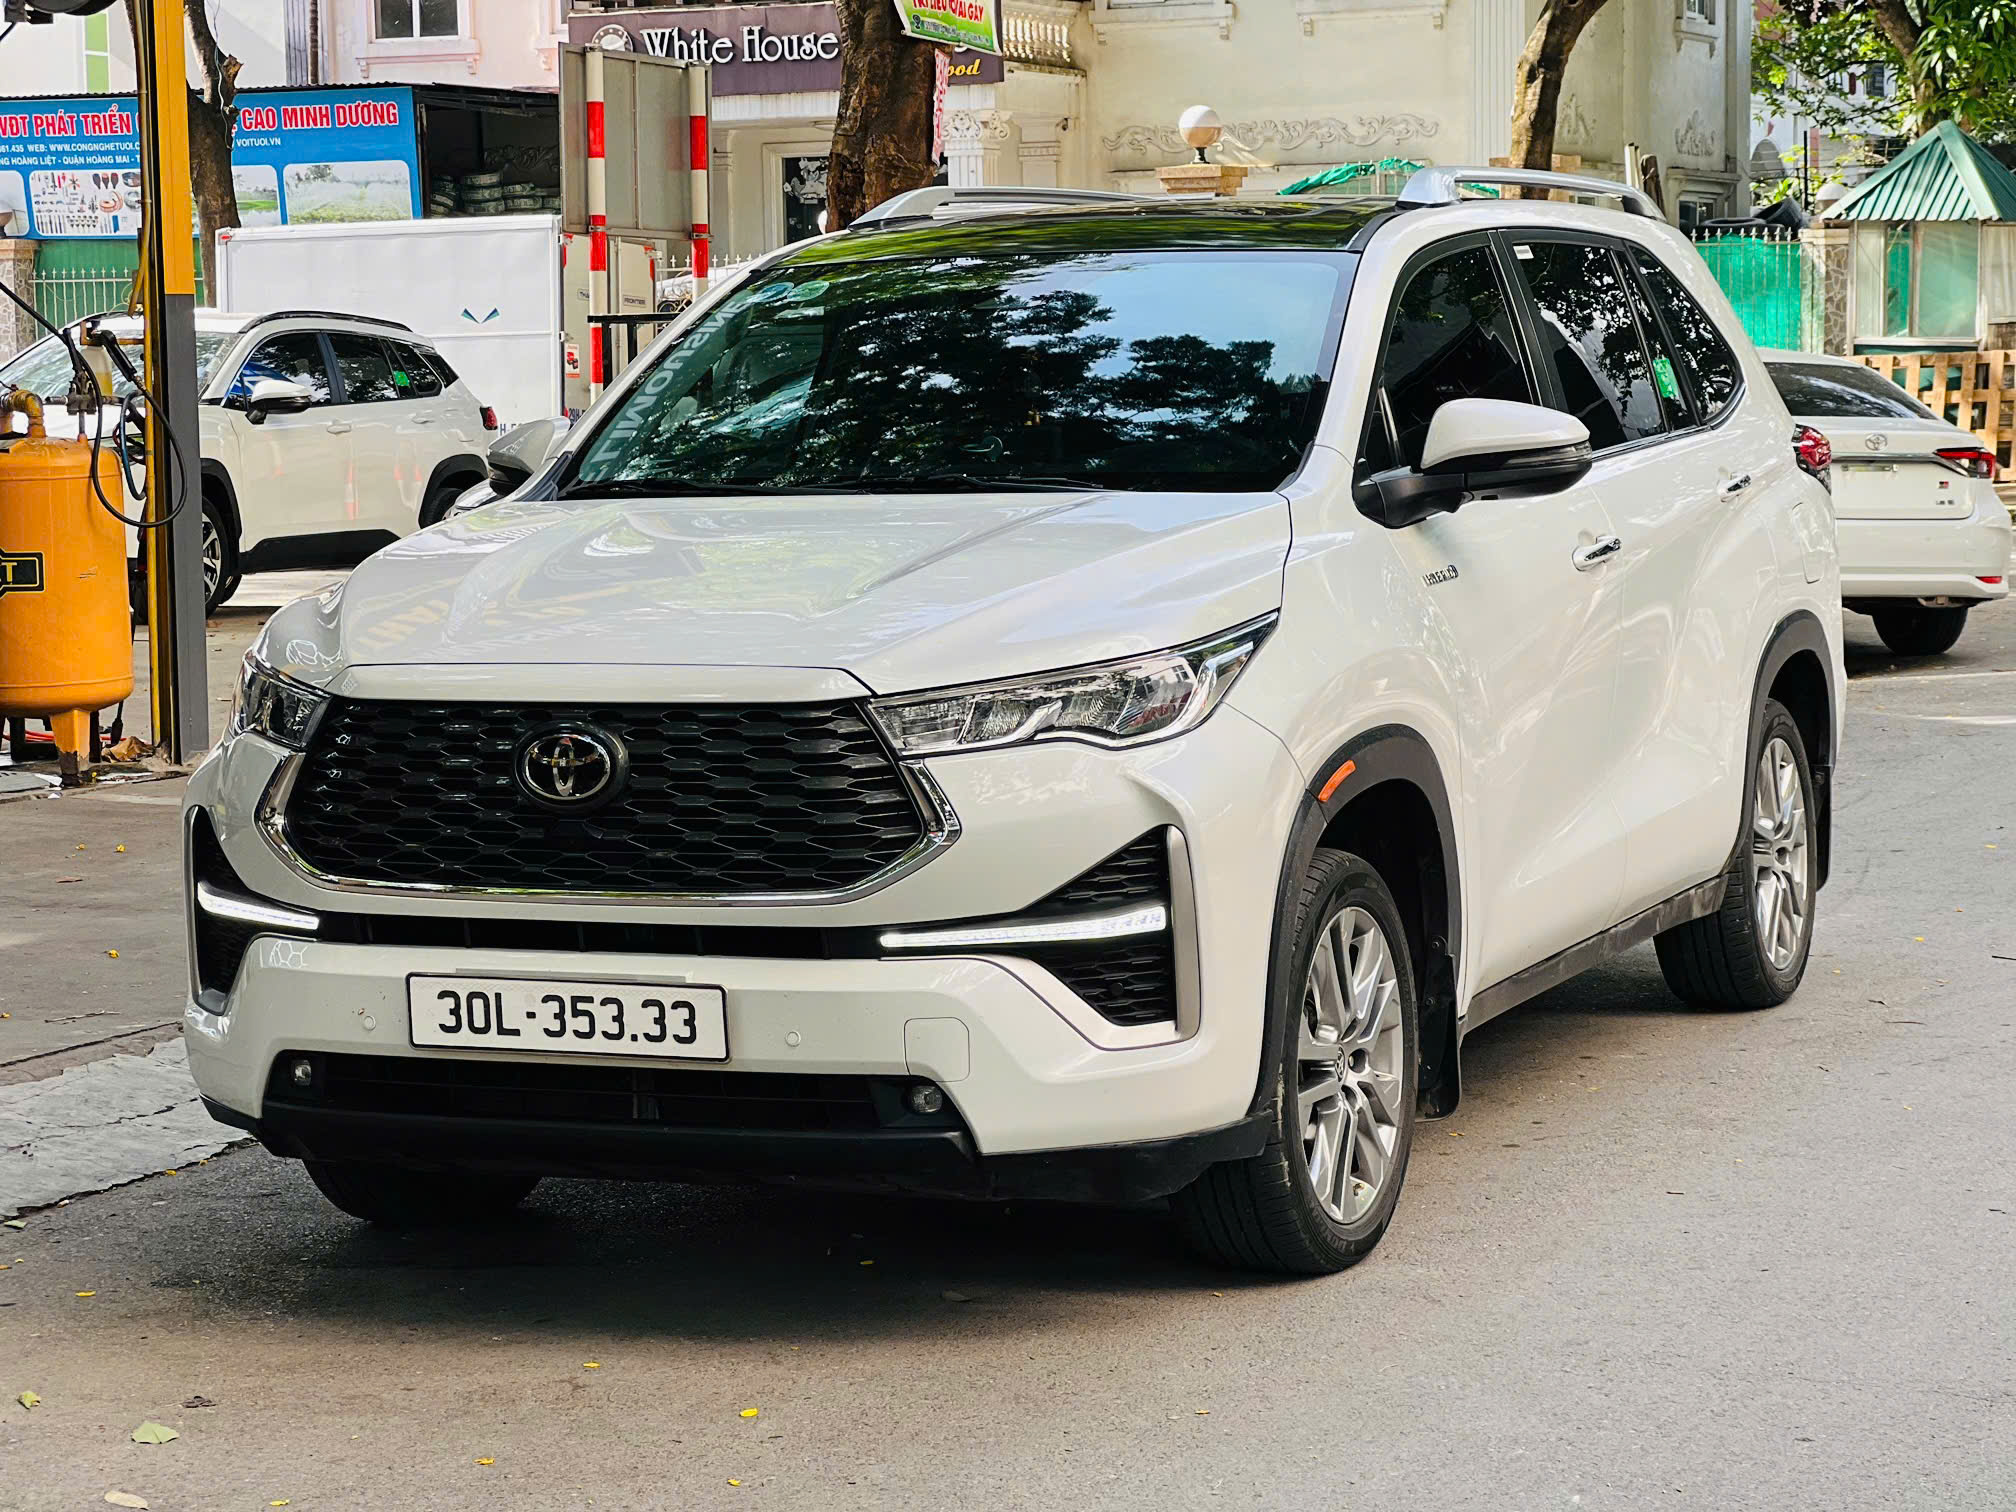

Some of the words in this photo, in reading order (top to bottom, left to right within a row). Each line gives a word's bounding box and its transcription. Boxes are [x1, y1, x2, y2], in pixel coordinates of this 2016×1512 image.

[640, 26, 734, 64] White
[739, 25, 839, 62] House
[33, 109, 77, 136] PHÁT
[80, 104, 132, 136] TRIỂN
[241, 107, 277, 131] CAO
[282, 105, 331, 129] MINH
[335, 101, 399, 127] DƯƠNG
[11, 155, 38, 165] HOÀNG
[40, 154, 56, 167] LIỆT
[62, 154, 84, 166] QUẬN
[86, 154, 113, 164] HOÀNG
[115, 154, 129, 163] MAI
[437, 990, 697, 1044] 30L-353.33
